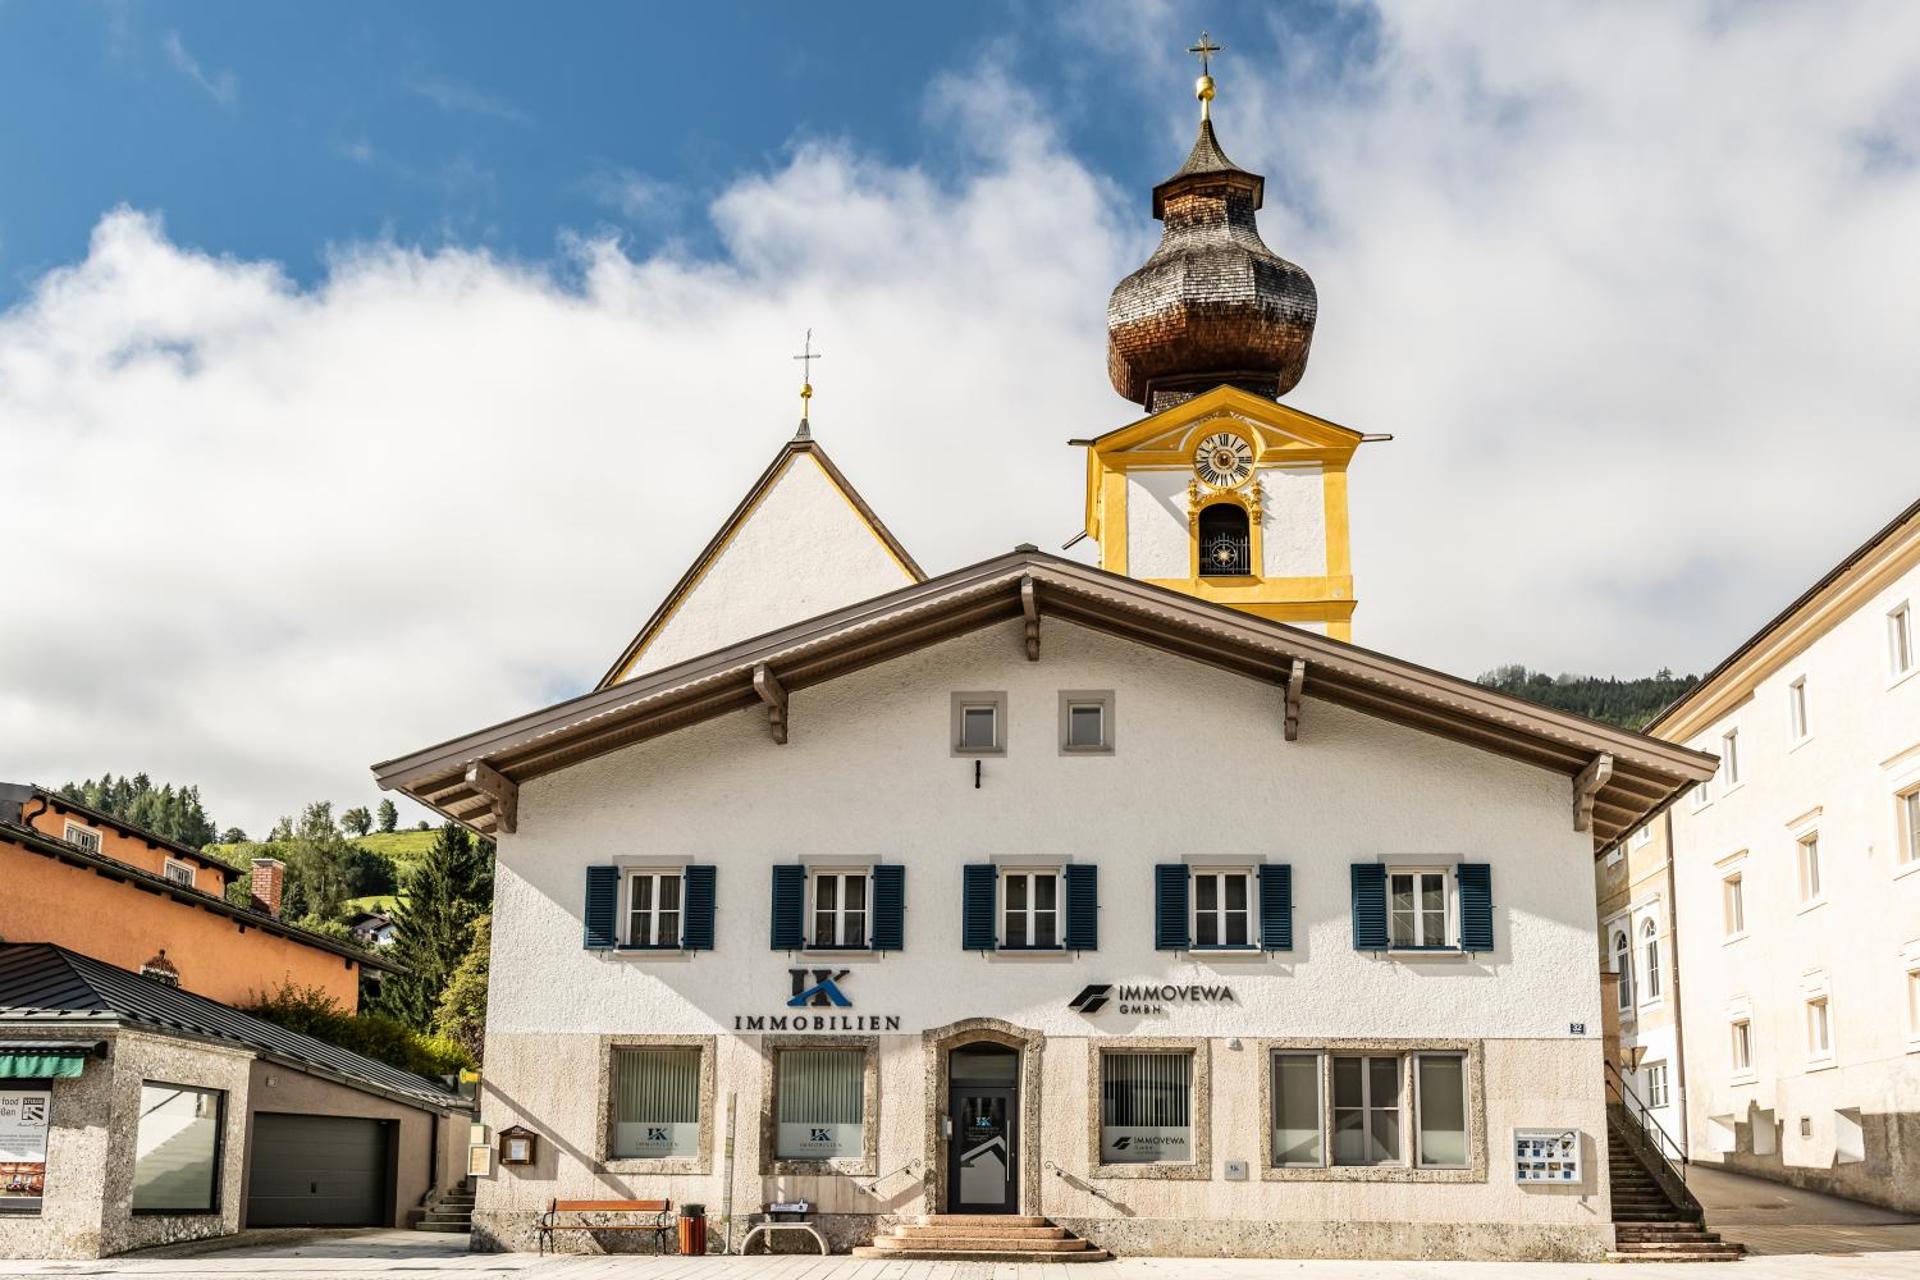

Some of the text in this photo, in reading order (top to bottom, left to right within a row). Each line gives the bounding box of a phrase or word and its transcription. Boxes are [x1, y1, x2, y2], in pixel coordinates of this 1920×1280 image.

[1119, 984, 1234, 1002] IMMOVEWA
[1119, 1004, 1161, 1015] GMBH
[734, 1015, 900, 1031] IMMOBILIEN
[1133, 1137, 1185, 1145] IMMOVEWA
